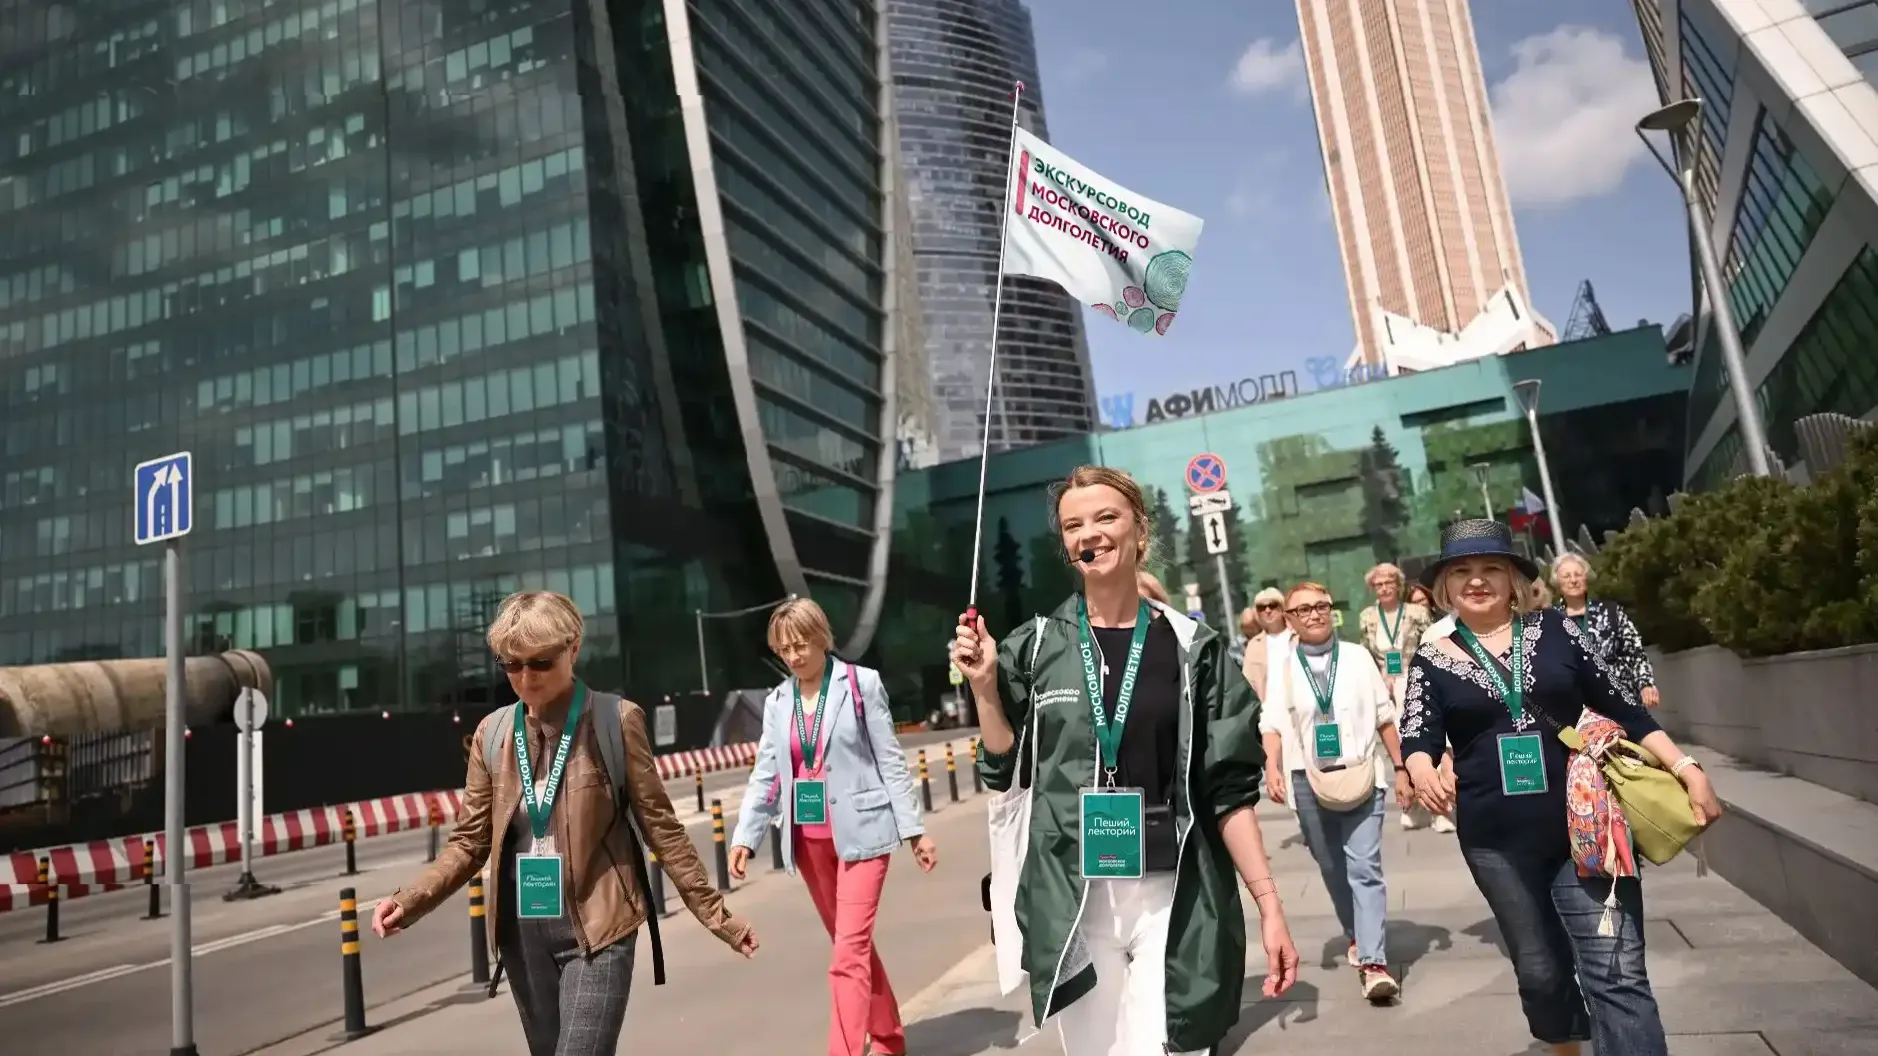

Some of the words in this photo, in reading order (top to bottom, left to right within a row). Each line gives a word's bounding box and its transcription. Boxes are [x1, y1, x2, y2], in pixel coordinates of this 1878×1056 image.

[1031, 181, 1150, 250] МОСКОВСКОГО
[1034, 158, 1150, 229] ЭКСКУРСОВОД
[1028, 205, 1129, 263] ДОЛГОЛЕТИЯ
[1146, 370, 1298, 423] АФИМОЛЛ
[1080, 641, 1106, 727] МОСКОВСКОЕ
[1114, 641, 1144, 724] ДОЛГОЛЕТИЕ
[1472, 641, 1508, 696] МОСКОВСКОЕ
[1514, 636, 1522, 693] ДОЛГОЛЕТИЕ
[514, 730, 535, 804] МОСКОВСКОЕ
[543, 733, 572, 806] ДОЛГОЛЕТИЕ
[1087, 826, 1136, 837] лекторий
[1094, 818, 1130, 827] Пеший
